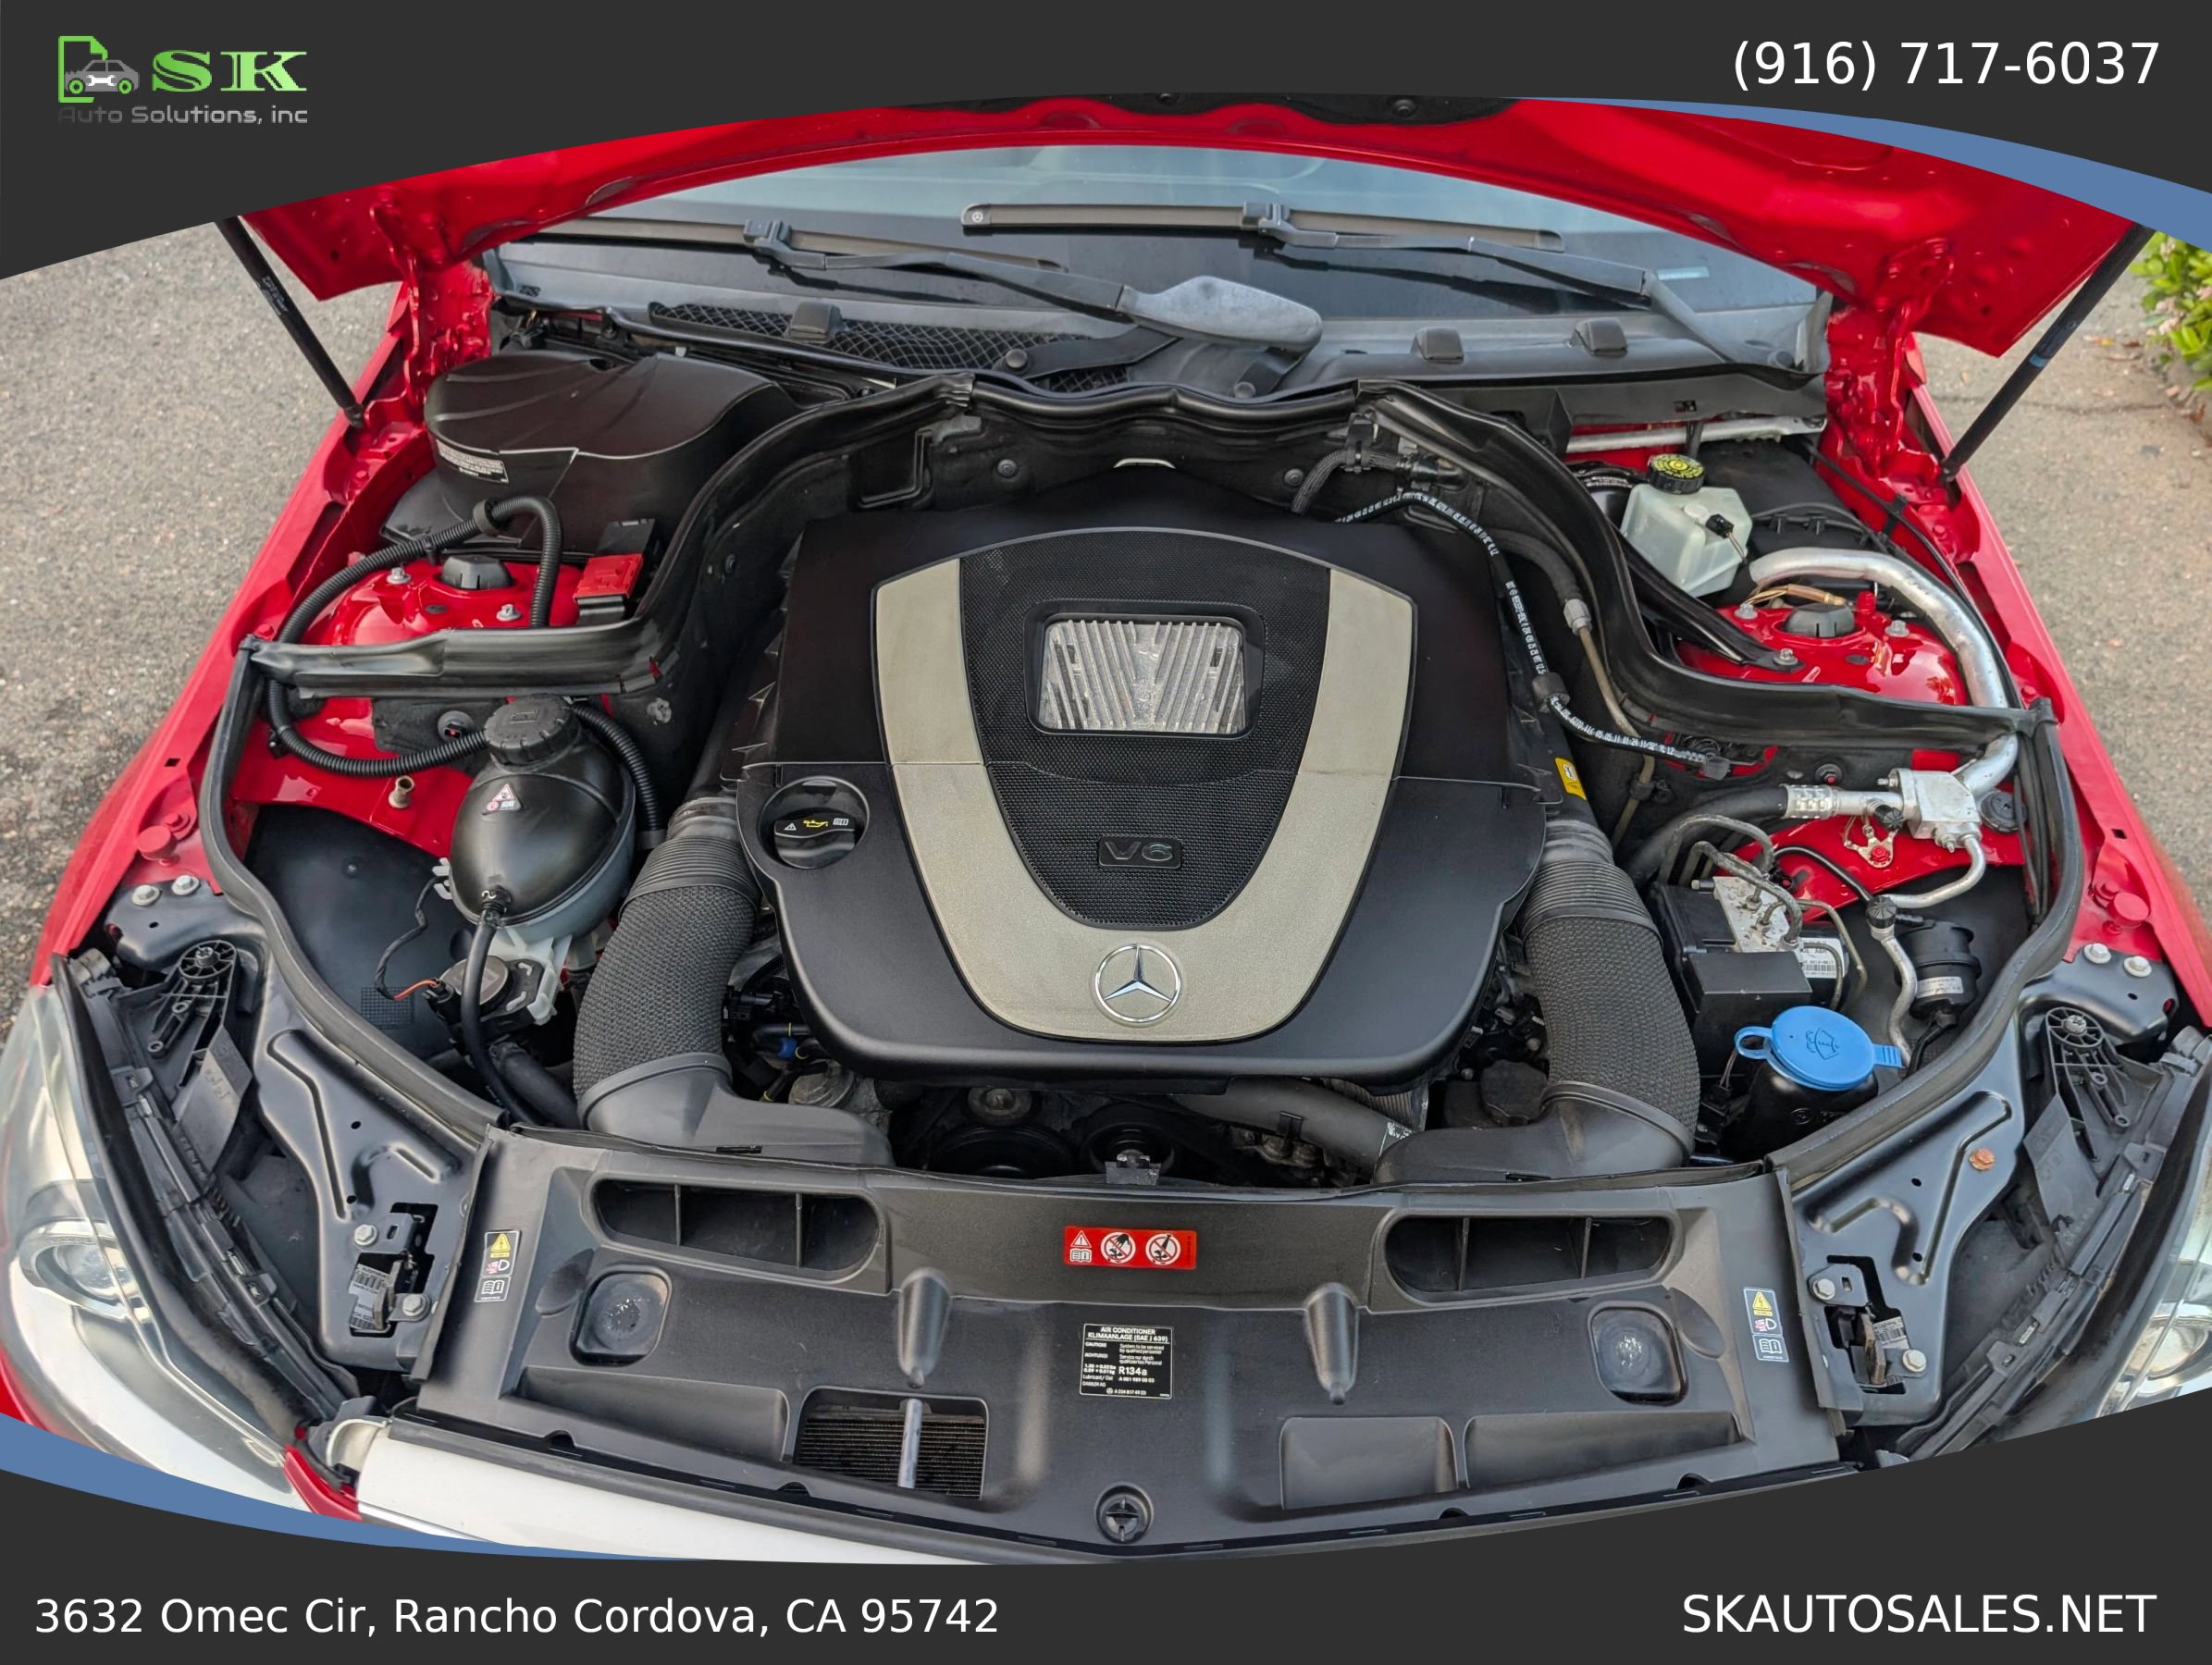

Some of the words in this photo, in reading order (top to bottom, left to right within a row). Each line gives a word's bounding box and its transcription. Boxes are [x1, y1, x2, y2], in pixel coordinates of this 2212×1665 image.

[1104, 841, 1173, 862] V6
[1087, 1332, 1133, 1340] KLIMAANLAGE
[1118, 1366, 1148, 1375] R134a
